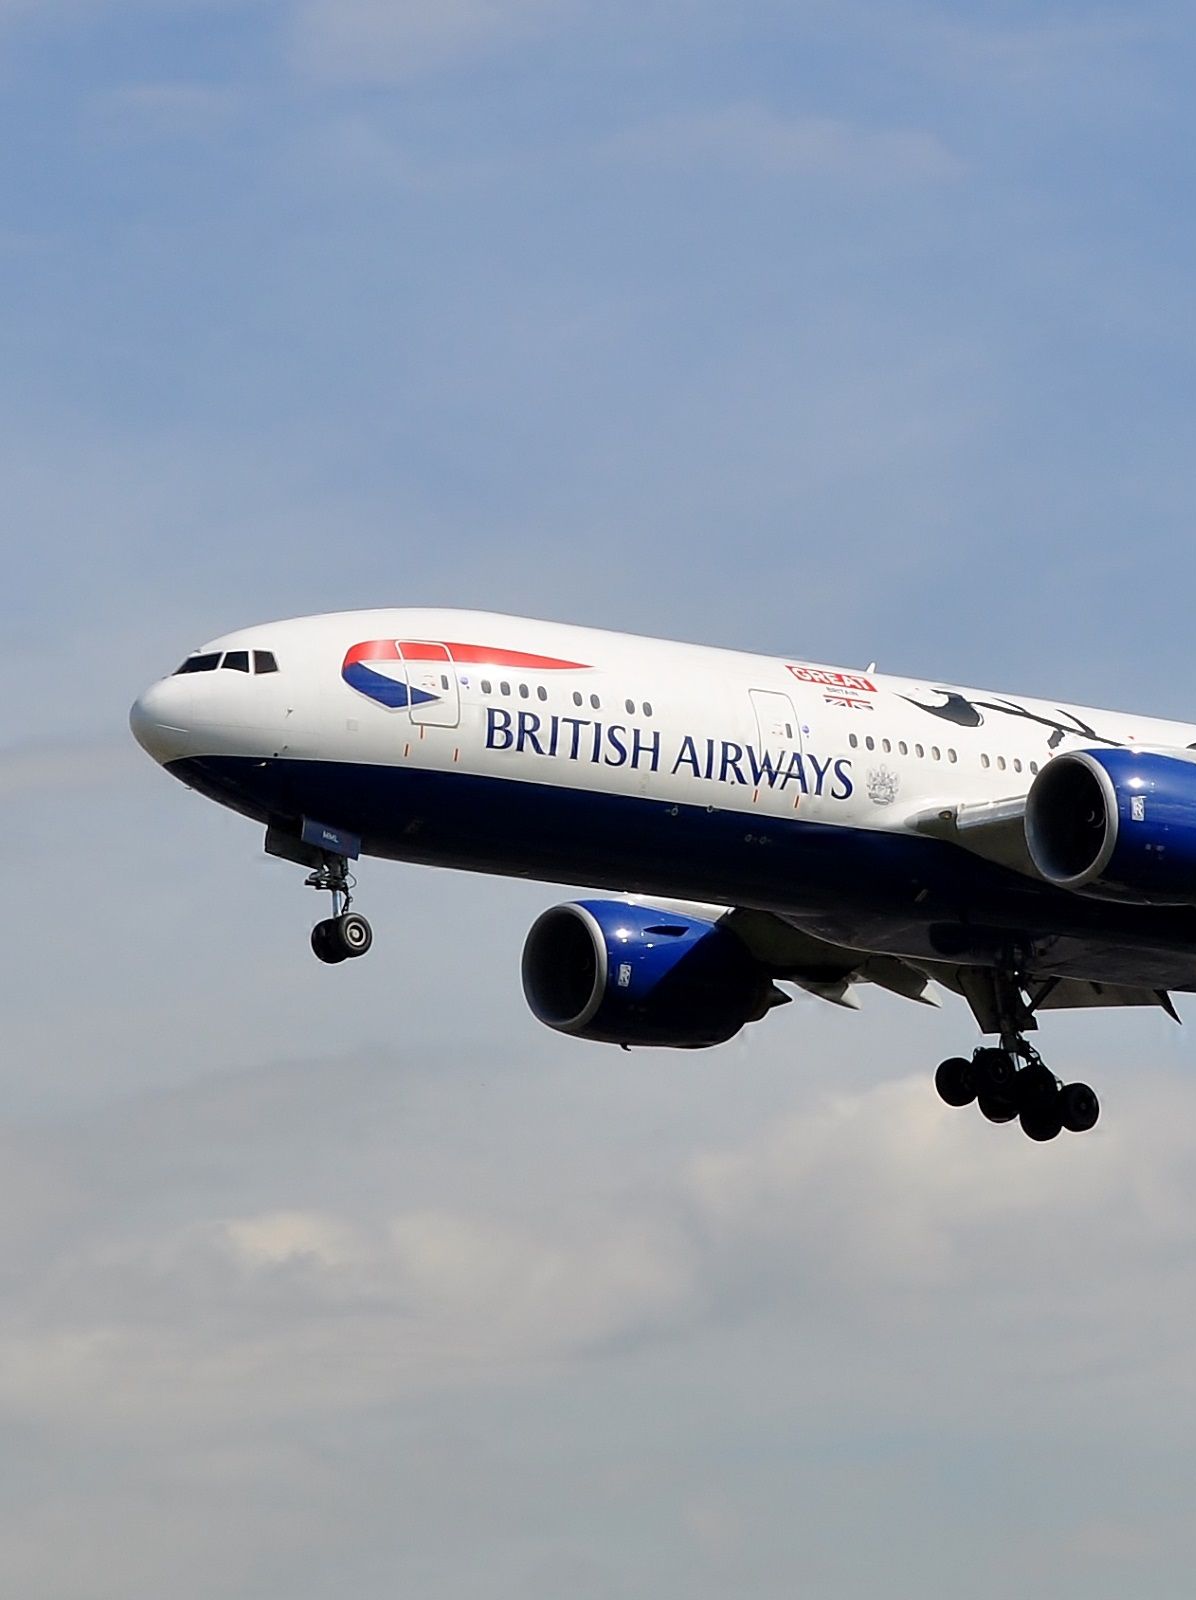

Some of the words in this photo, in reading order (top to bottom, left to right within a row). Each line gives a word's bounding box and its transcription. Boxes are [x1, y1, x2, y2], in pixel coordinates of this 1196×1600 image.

[791, 667, 871, 690] GREAT
[485, 707, 660, 772] BRITISH
[671, 736, 854, 800] AIRWAYS
